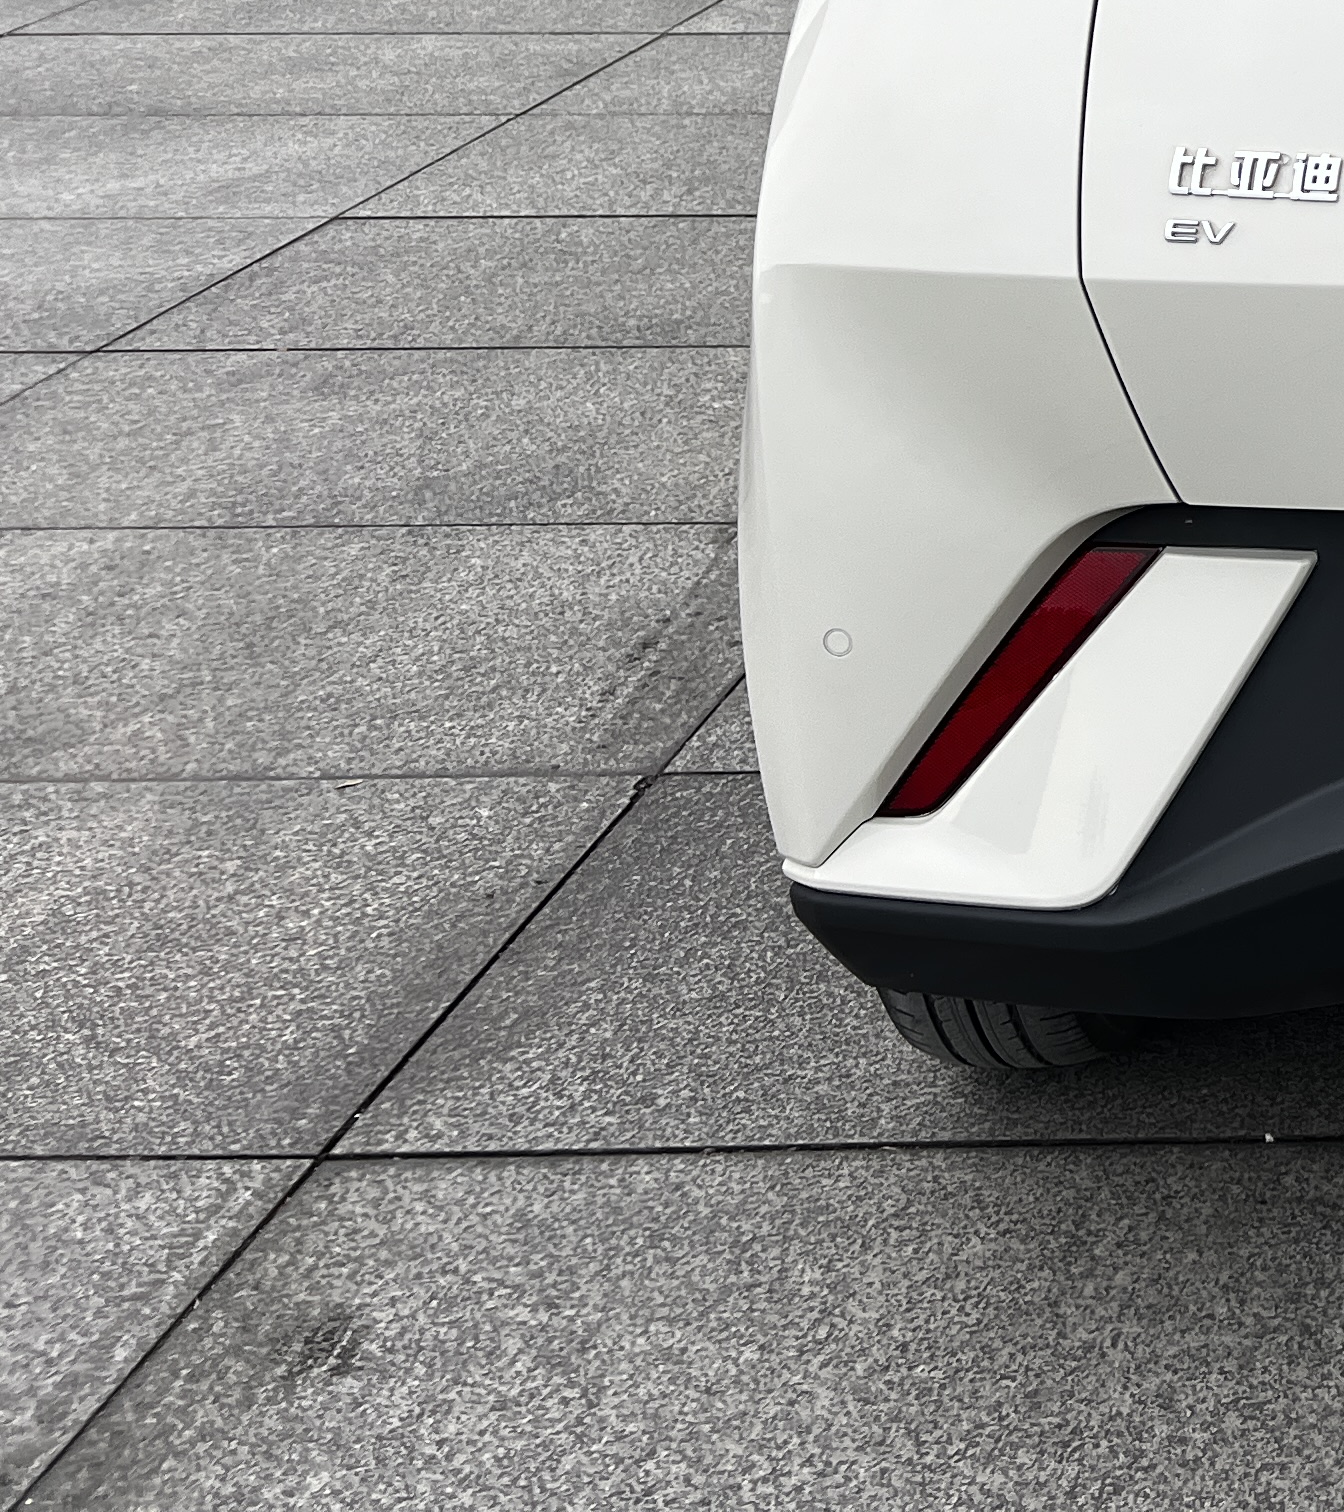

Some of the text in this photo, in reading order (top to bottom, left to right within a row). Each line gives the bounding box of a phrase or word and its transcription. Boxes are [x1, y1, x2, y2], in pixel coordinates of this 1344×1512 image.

[1168, 145, 1344, 204] 比亚迪
[1164, 218, 1237, 246] EV
